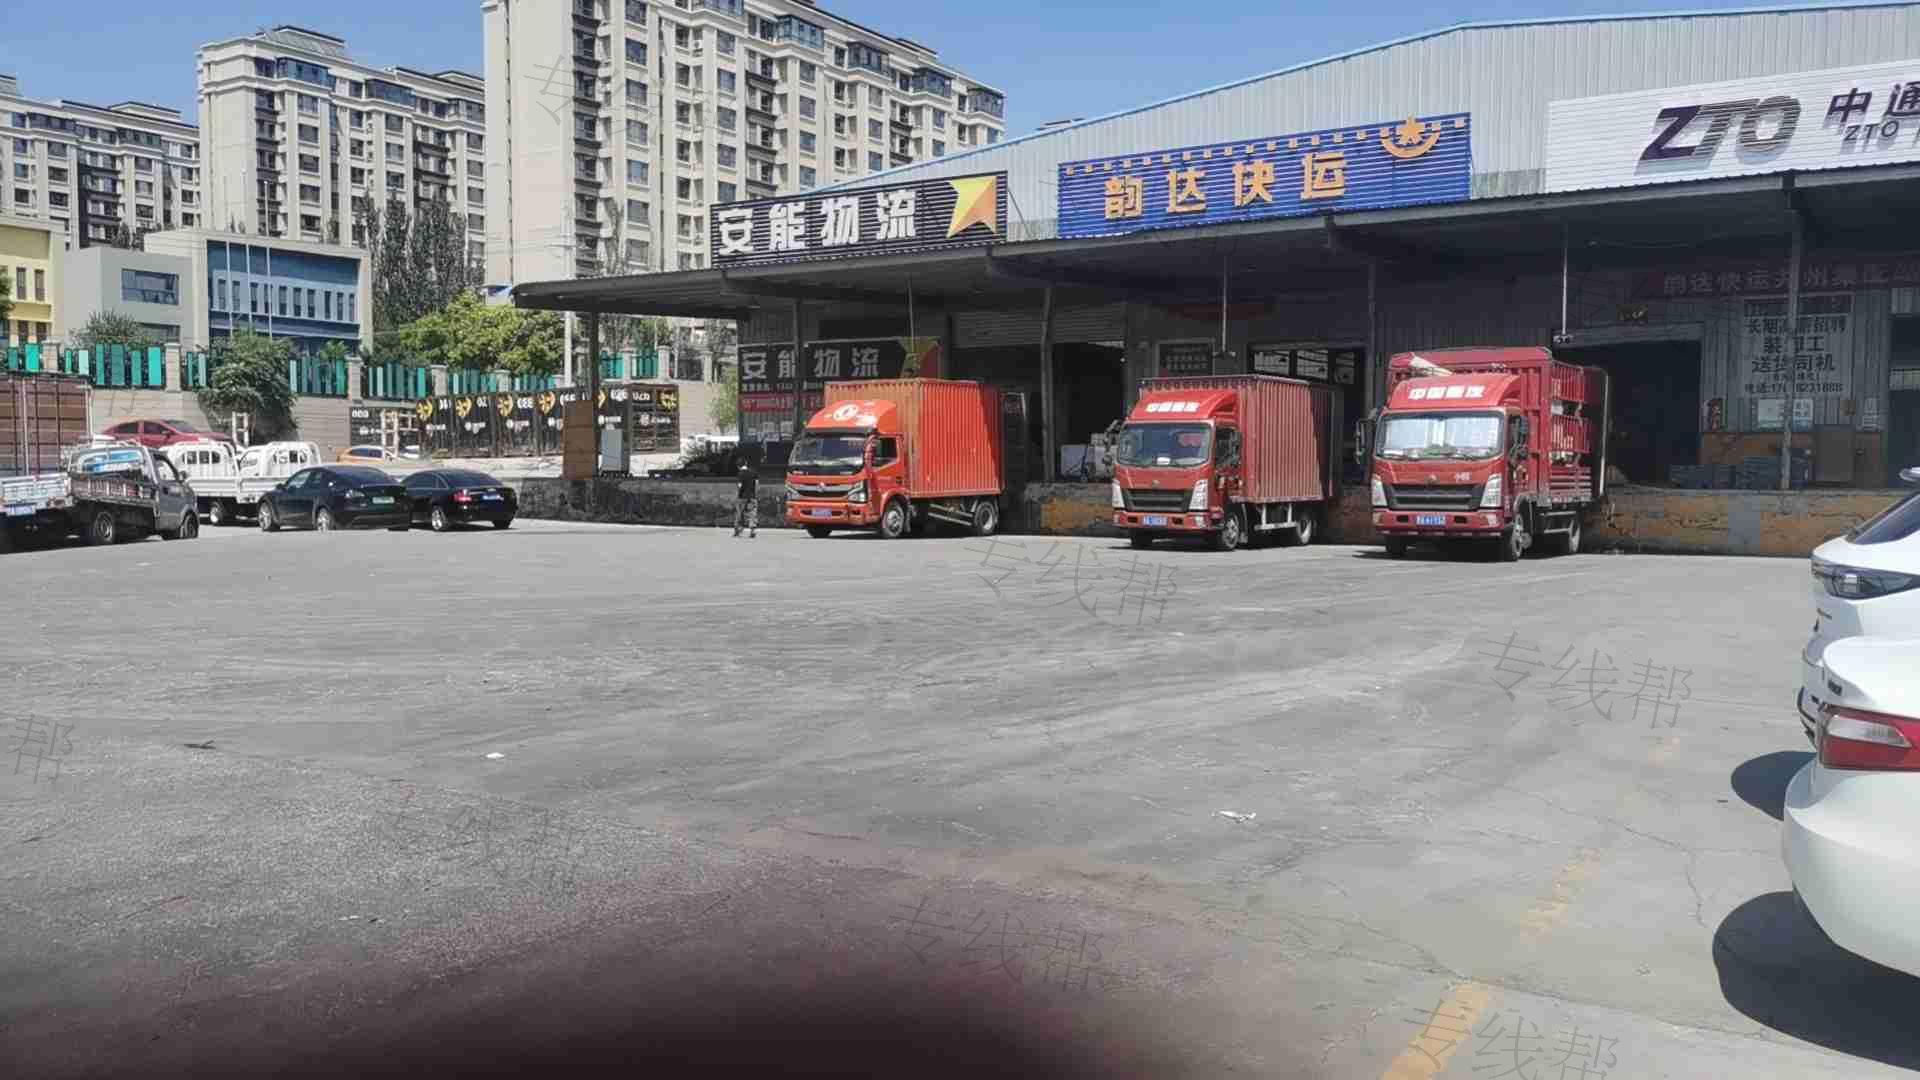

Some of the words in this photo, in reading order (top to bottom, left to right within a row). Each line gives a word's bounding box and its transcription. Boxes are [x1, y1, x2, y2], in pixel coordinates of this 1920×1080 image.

[1823, 80, 1920, 122] 中通
[1640, 96, 1801, 160] ZTO
[1843, 120, 1899, 142] ZTO
[1104, 151, 1346, 219] 韵达快运
[719, 190, 916, 255] 安能物流
[742, 348, 879, 380] 安能物流
